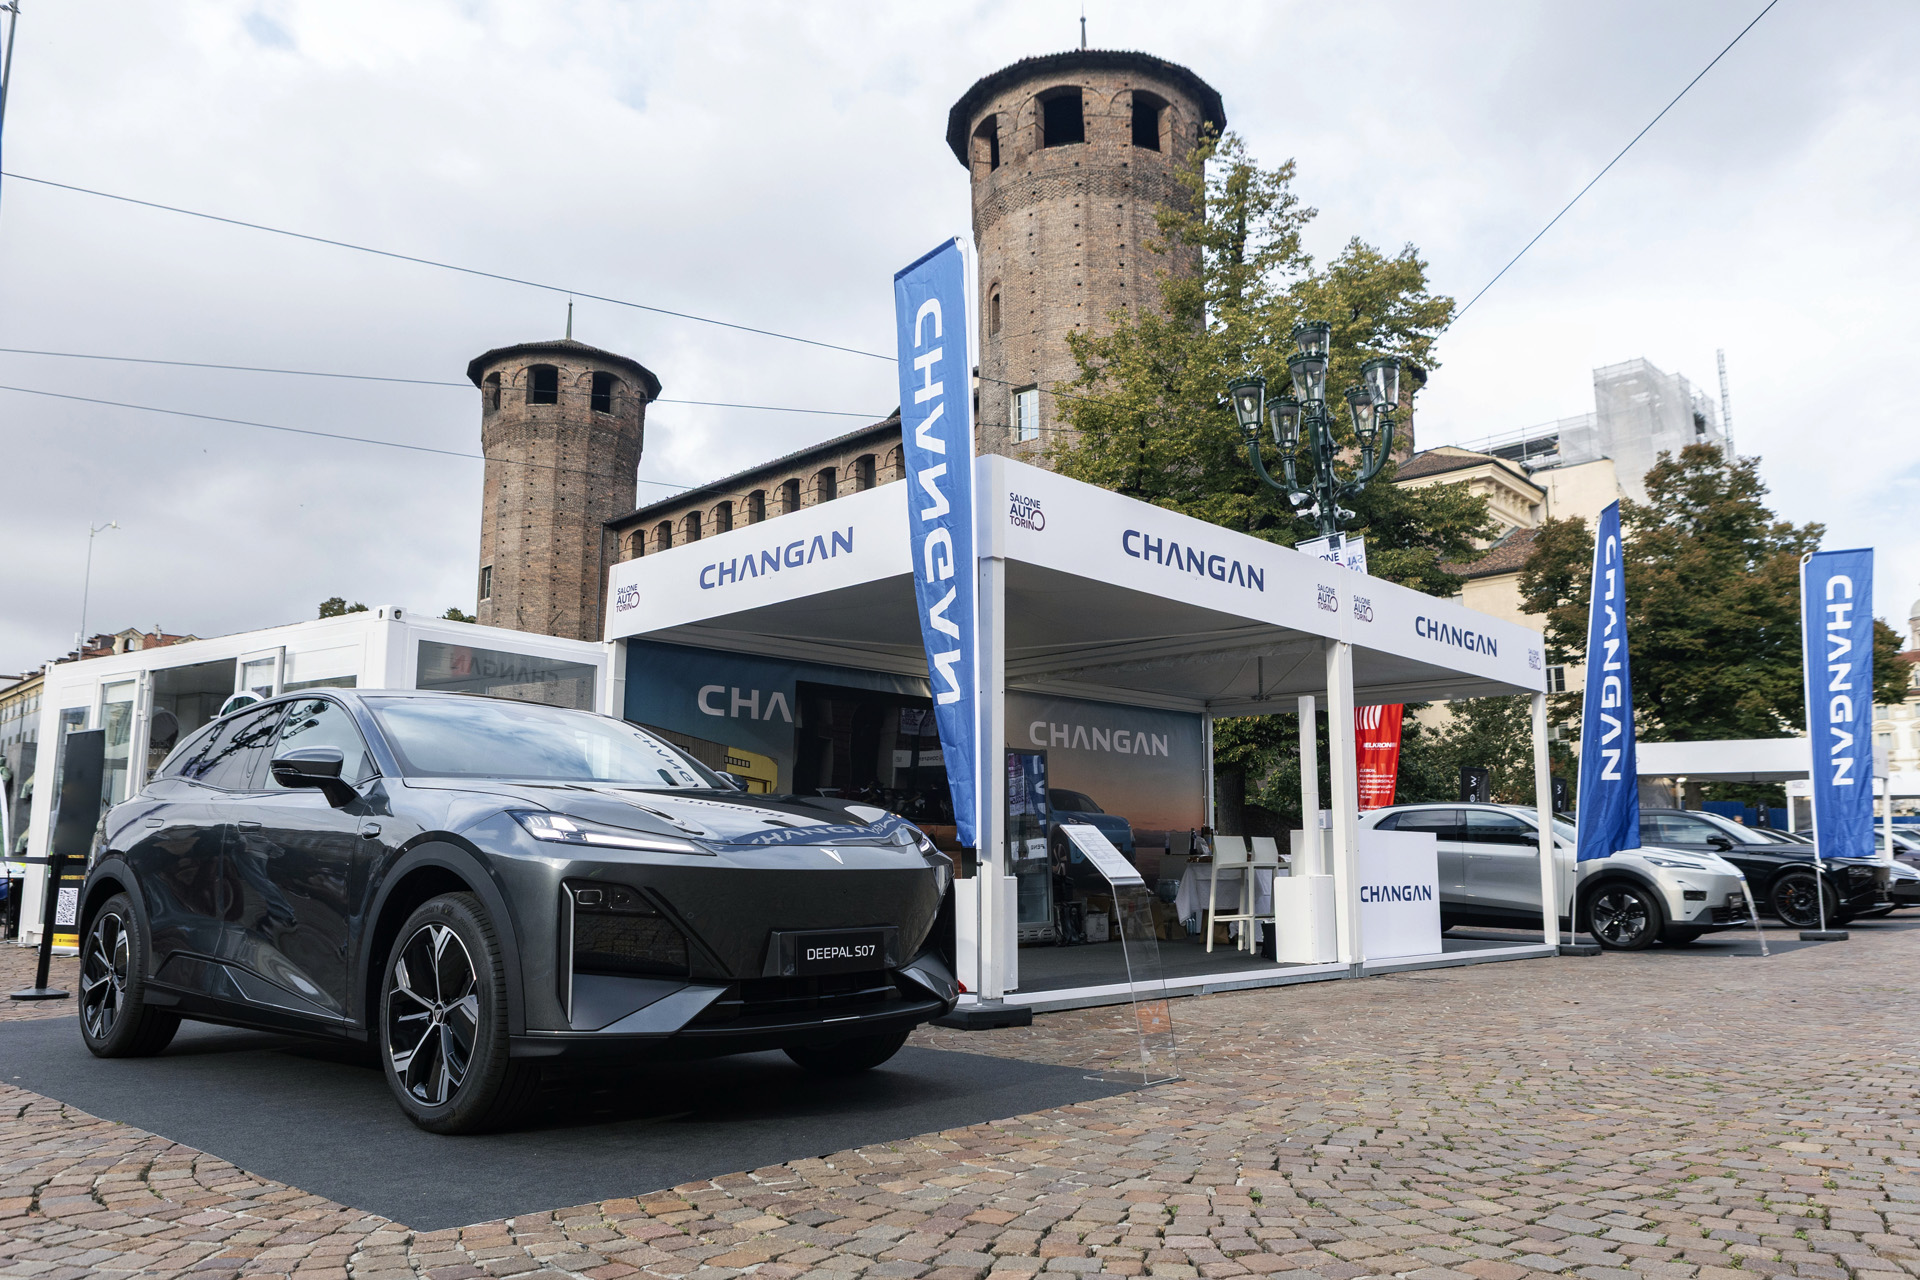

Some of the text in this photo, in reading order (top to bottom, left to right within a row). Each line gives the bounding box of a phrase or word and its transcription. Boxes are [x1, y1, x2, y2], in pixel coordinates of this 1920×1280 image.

[1009, 492, 1041, 509] SALONE
[699, 526, 854, 590] CHANGAN
[1122, 529, 1264, 592] CHANGAN
[616, 583, 638, 595] SALONE
[1317, 583, 1336, 595] SALONE
[1353, 595, 1371, 606] SALONE
[1415, 616, 1497, 657] CHANGAN
[1826, 575, 1855, 786] CHANGAN
[698, 684, 793, 723] CHA
[1029, 720, 1169, 757] CHANGAN
[1360, 885, 1432, 902] CHANGAN
[806, 944, 876, 961] DEEPAL S07
